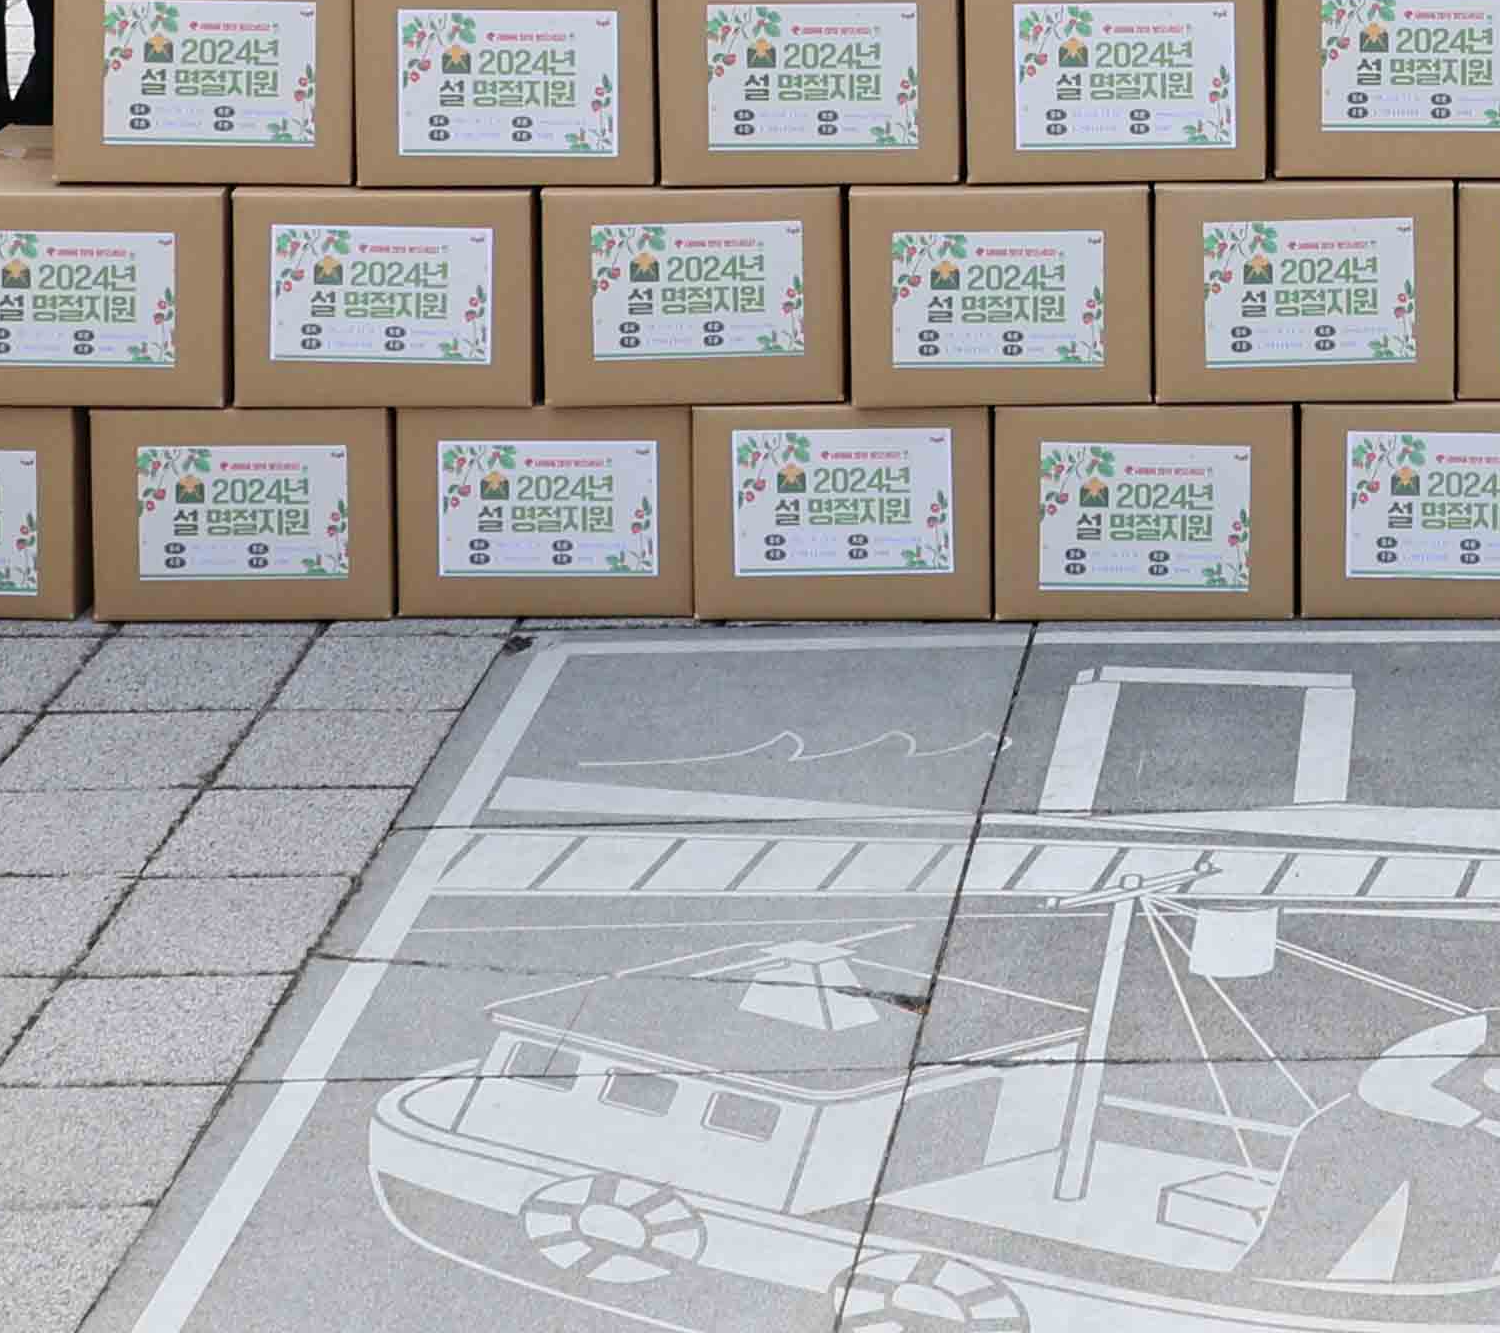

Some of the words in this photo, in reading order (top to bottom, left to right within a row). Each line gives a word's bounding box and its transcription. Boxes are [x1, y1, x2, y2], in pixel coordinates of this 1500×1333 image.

[181, 38, 277, 65] 2024년
[1396, 28, 1492, 54] 2024년
[784, 42, 879, 69] 2024년
[140, 68, 166, 96] 설
[174, 69, 277, 97] 명절지원
[1357, 58, 1382, 85] 설
[1390, 59, 1492, 84] 명절지원
[744, 74, 769, 102] 설
[778, 74, 880, 101] 명절지원
[39, 266, 135, 291] 2024년
[667, 255, 764, 282] 2024년
[1280, 256, 1376, 284] 2024년
[0, 294, 24, 320] 설
[33, 295, 135, 321] 명절지원
[628, 288, 653, 314] 설
[662, 285, 765, 313] 명절지원
[1241, 290, 1266, 318] 설
[1275, 288, 1377, 317] 명절지원
[517, 476, 614, 501] 2024년
[478, 505, 503, 532] 설
[511, 506, 614, 531] 명절지원
